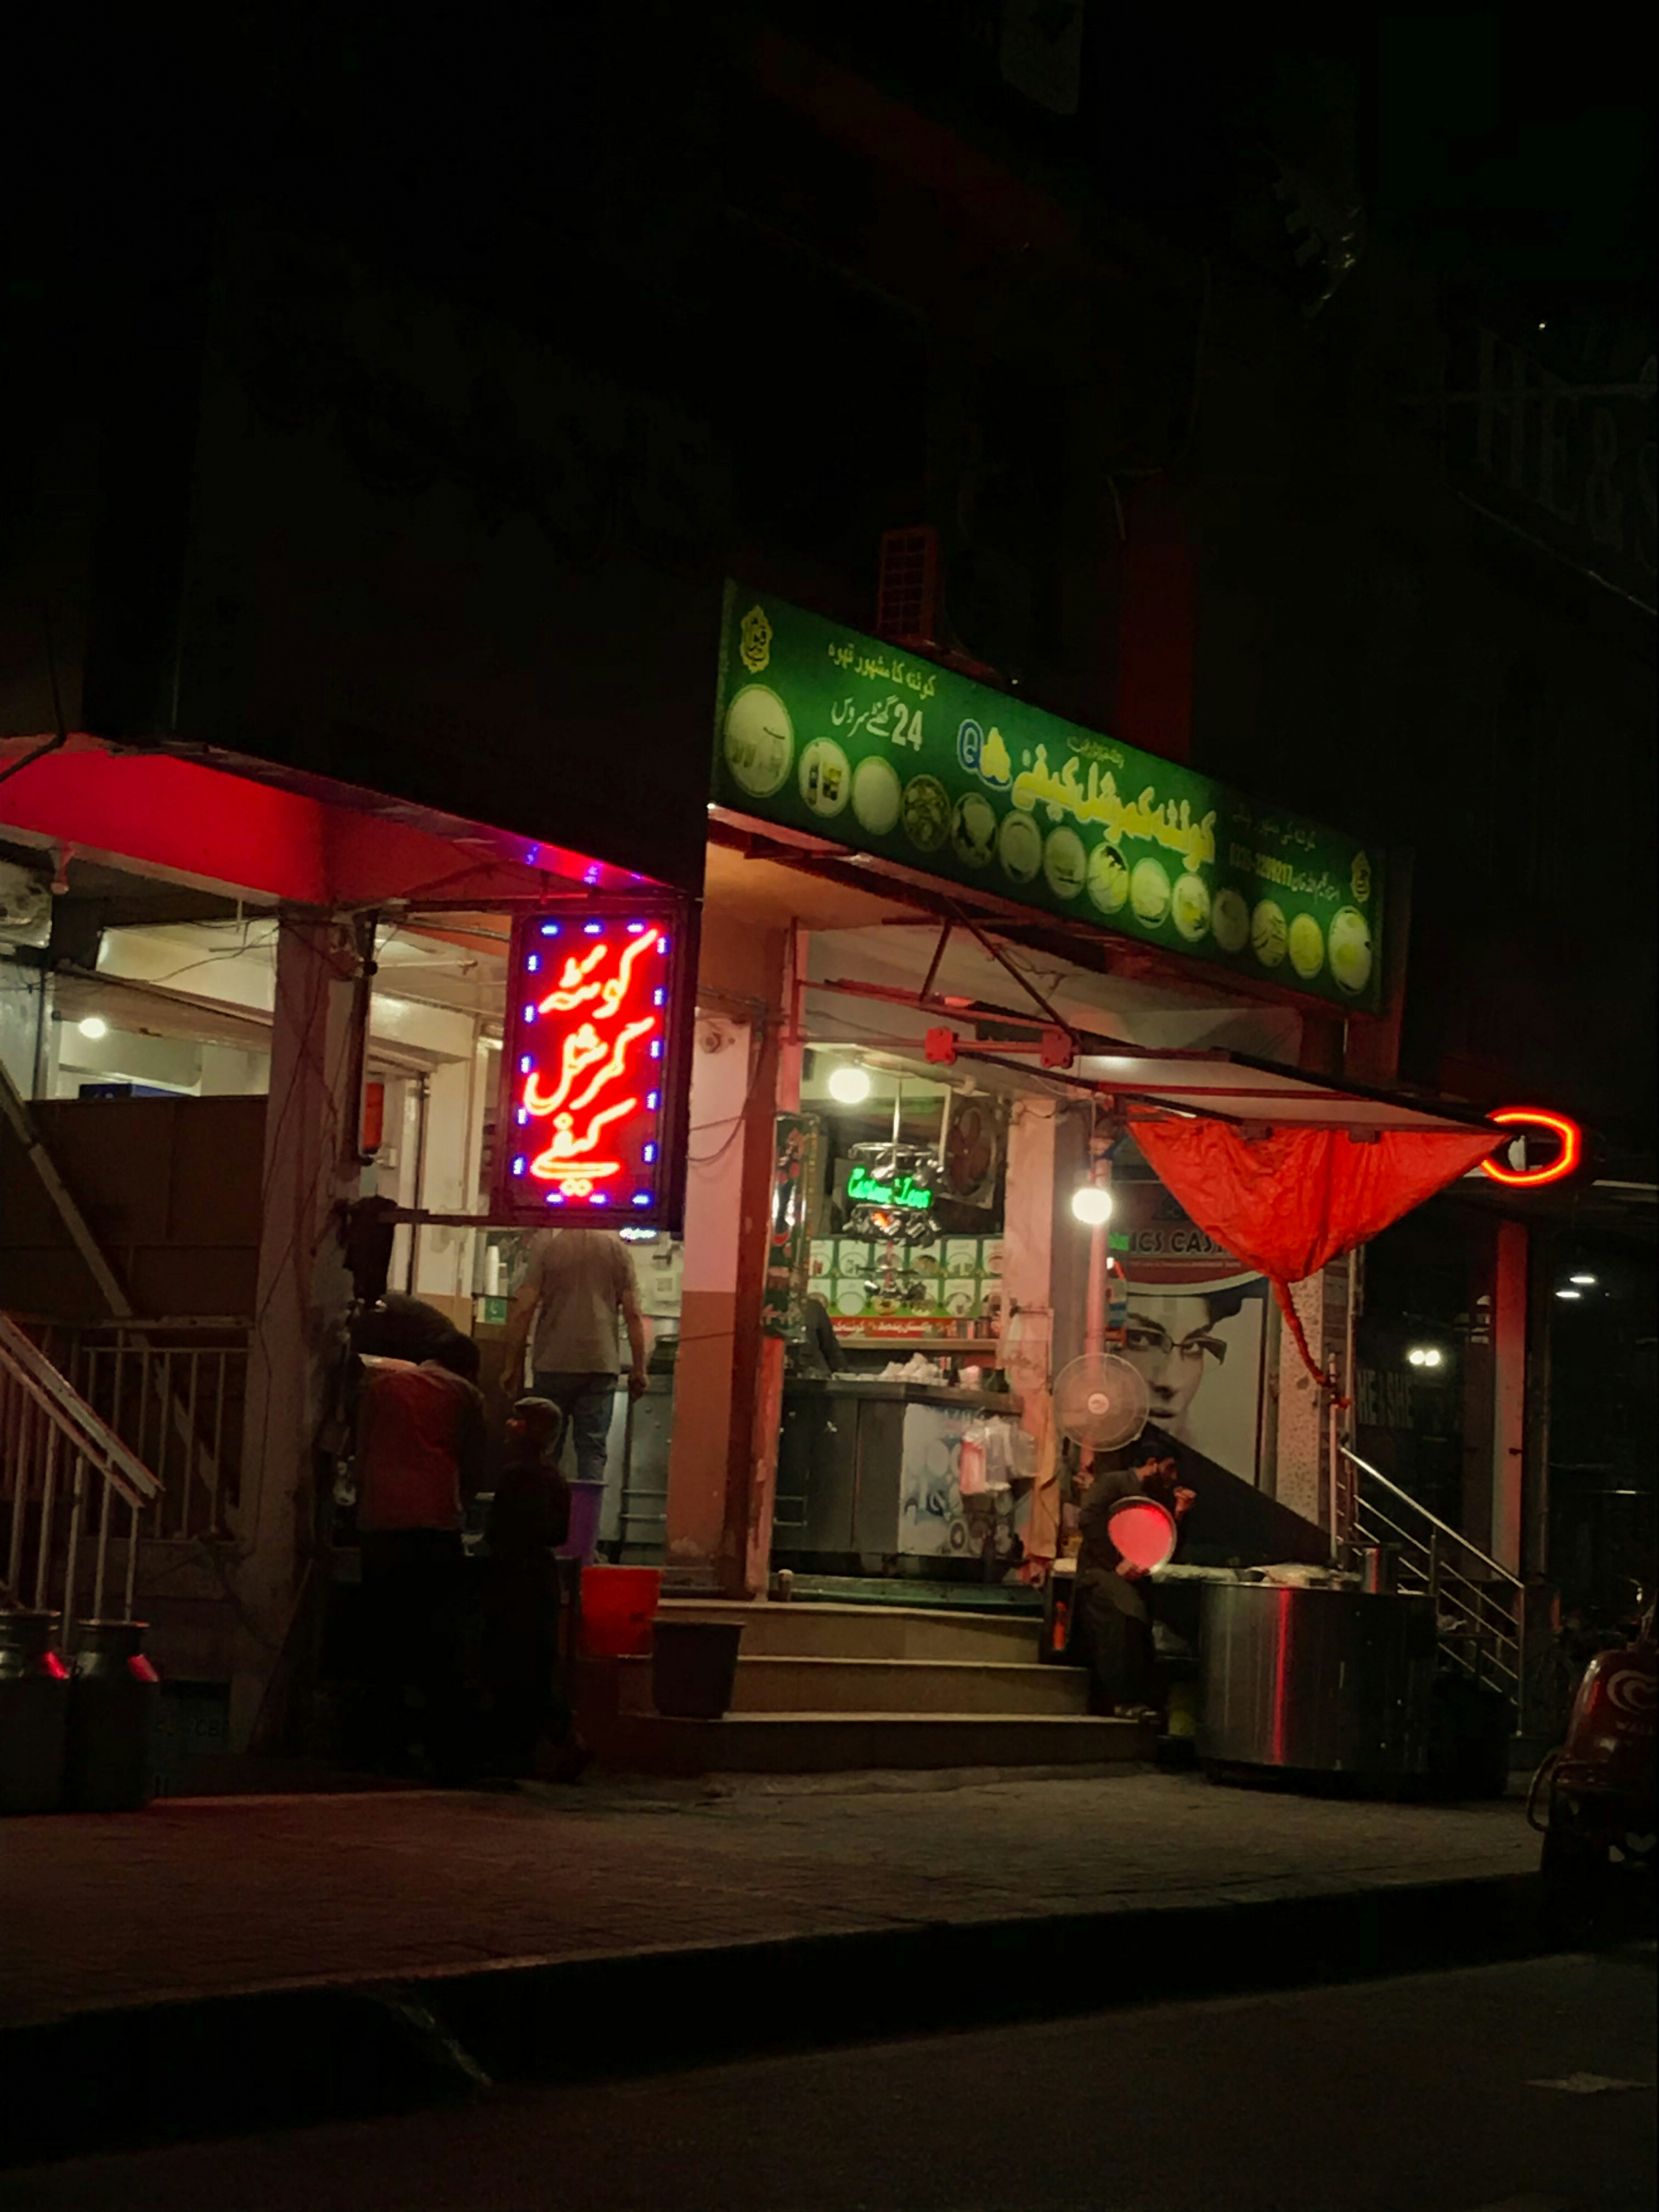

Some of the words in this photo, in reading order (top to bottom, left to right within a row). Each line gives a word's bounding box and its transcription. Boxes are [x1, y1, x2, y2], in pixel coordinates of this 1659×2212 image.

[891, 703, 923, 751] 24
[538, 928, 658, 1018] کوئٹہ
[1129, 1232, 1163, 1252] ICS
